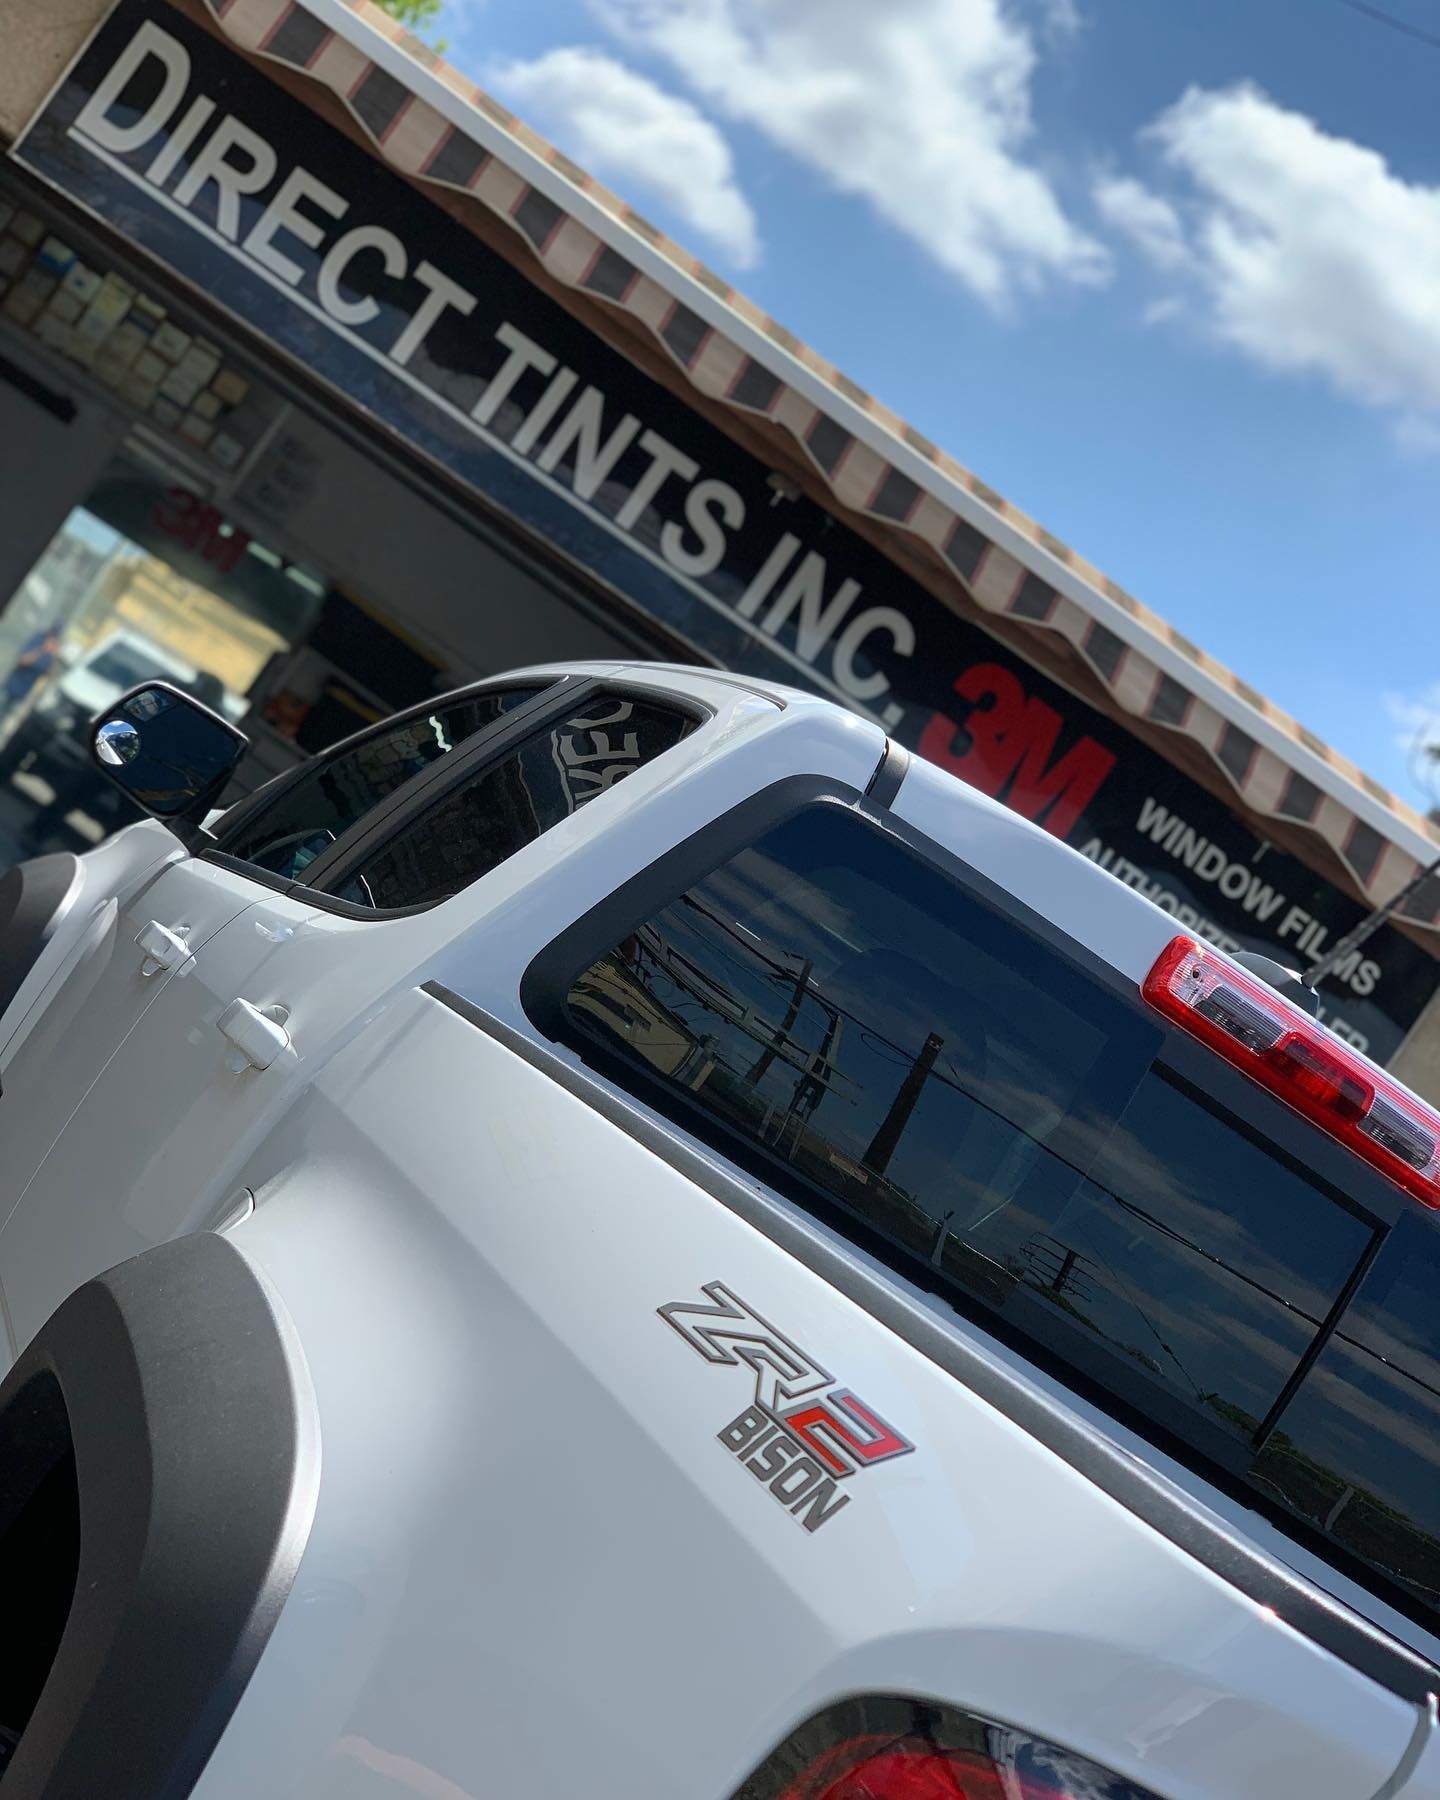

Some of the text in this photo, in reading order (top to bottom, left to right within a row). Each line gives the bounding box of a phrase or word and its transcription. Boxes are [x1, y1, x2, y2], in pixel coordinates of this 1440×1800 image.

[74, 19, 478, 366] DIRECT
[471, 321, 746, 578] TINTS
[918, 662, 1118, 840] 3M
[1136, 797, 1382, 996] WINDOW FILMS
[656, 1280, 916, 1481] ZR2
[715, 1405, 851, 1533] BISON
